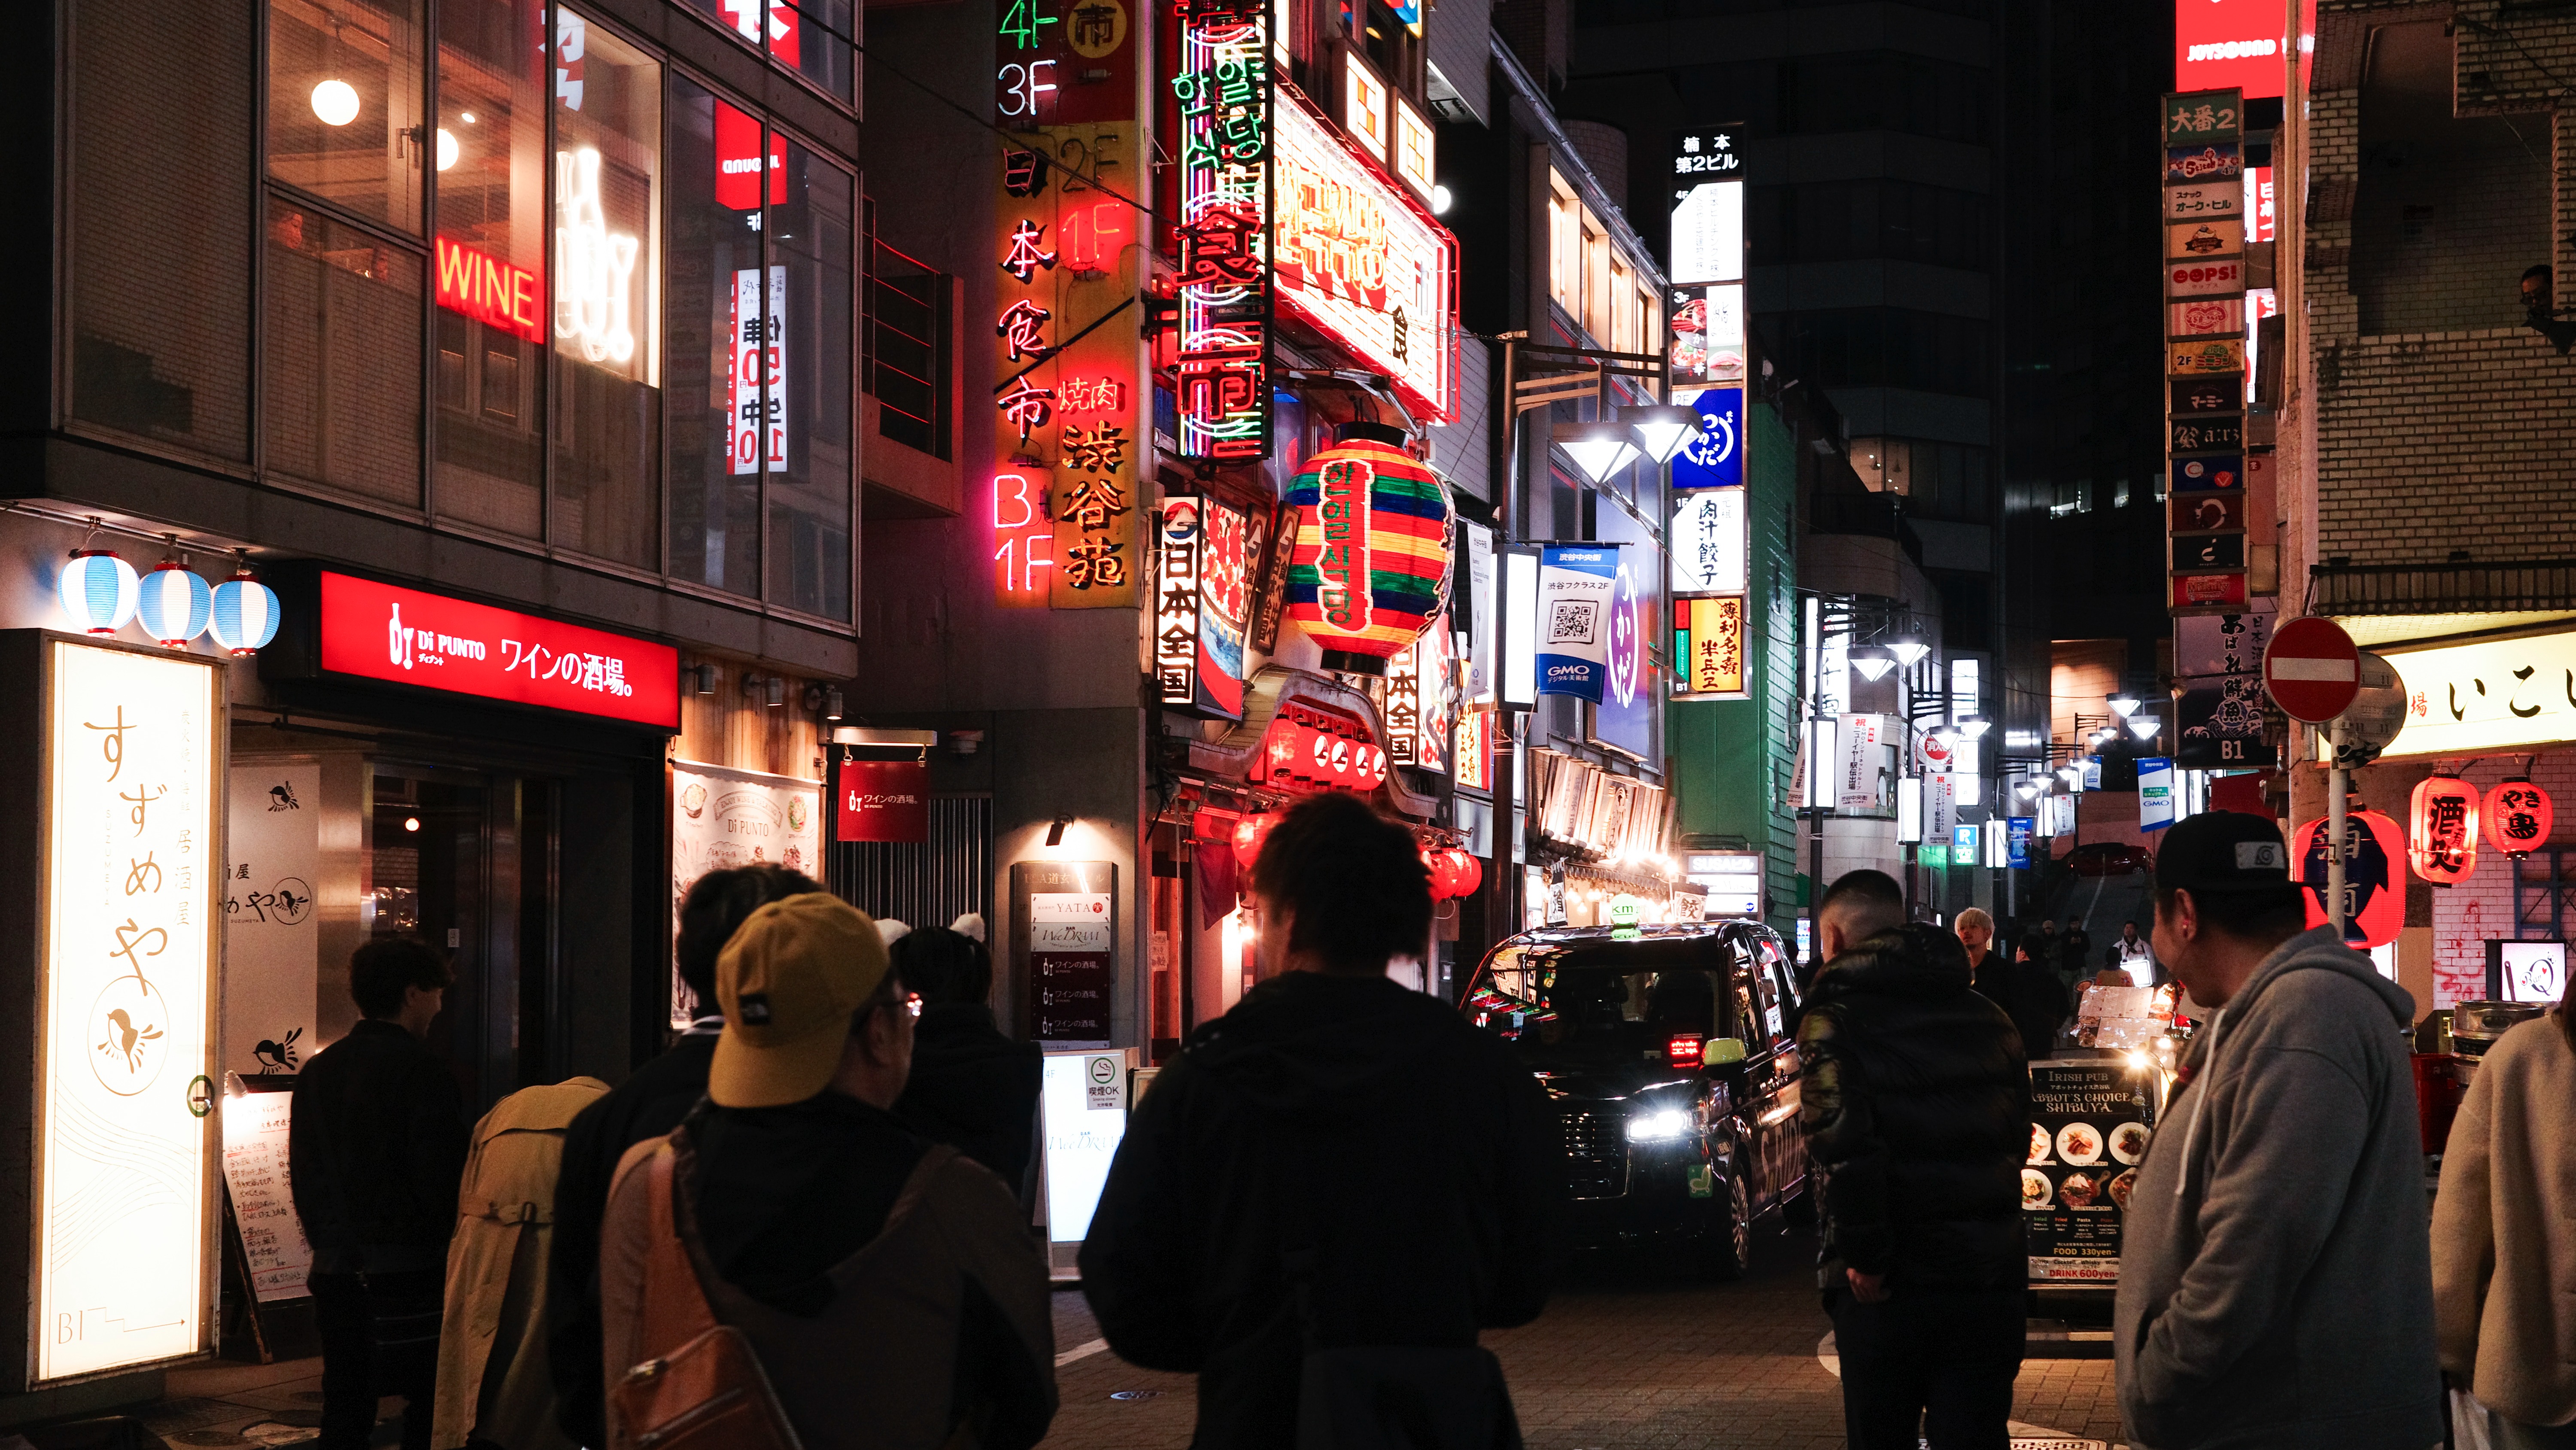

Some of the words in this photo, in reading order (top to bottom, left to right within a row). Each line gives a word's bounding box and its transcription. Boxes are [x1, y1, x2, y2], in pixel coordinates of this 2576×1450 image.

[2187, 39, 2276, 61] JOYSOUND
[999, 60, 1057, 115] 3F
[2171, 104, 2236, 132] 大番2
[1683, 134, 1730, 153] 楠本
[1060, 134, 1119, 192] 2F
[1675, 153, 1739, 173] 第2ビル
[1675, 190, 1689, 199] 4F
[2175, 200, 2232, 212] オーク・ヒル
[1062, 203, 1120, 262] 1F
[2173, 265, 2237, 283] OOPS!
[437, 237, 535, 327] WINE
[998, 148, 1054, 440] 日本食市
[1674, 291, 1689, 303] 3F
[1692, 333, 1706, 377] かに華
[2177, 356, 2192, 366] 2F
[1058, 377, 1118, 410] 焼肉
[1676, 395, 1689, 406] 2F
[1698, 413, 1720, 466] つかだ
[1062, 419, 1122, 587] 渋谷苑
[1676, 498, 1689, 508] 1F
[1698, 499, 1719, 585] 肉汁餃子
[1558, 553, 1602, 562] 渋谷中央街
[1547, 581, 1596, 590] 渋谷フクラス
[1159, 542, 1197, 700] 日本全国
[417, 629, 434, 651] Di
[437, 635, 486, 661] PUNTO
[501, 638, 633, 698] ワインの酒場。
[1547, 665, 1590, 676] GMO
[1547, 675, 1589, 684] デジタル美術館
[1676, 682, 1688, 692] B1
[2410, 691, 2428, 718] 場
[1855, 718, 1866, 727] 祝
[1926, 740, 1950, 752] 消火
[2221, 739, 2245, 760] B1
[1848, 727, 1861, 790] ニューイヤー駅伝出場
[737, 795, 750, 804] WINE
[864, 794, 919, 805] ワインの酒場。
[2500, 790, 2540, 809] やき
[728, 819, 737, 833] Di
[740, 823, 769, 836] PUNTO
[83, 705, 168, 997] すずめや
[103, 809, 112, 907] SUZUMEYA
[174, 828, 193, 926] 居酒屋
[1057, 903, 1091, 912] YATA
[1612, 905, 1633, 913] km
[1055, 961, 1100, 969] ワインの酒場。
[1055, 990, 1100, 999] ワインの酒場。
[1054, 1020, 1099, 1028] ワインの酒場。
[1045, 1070, 1055, 1079] 4F
[2086, 1073, 2109, 1082] PUB
[1089, 1086, 1119, 1096] 喫煙OK
[2084, 1092, 2131, 1102] CHOICE
[2046, 1102, 2113, 1113] SHIBUYA
[2081, 1248, 2117, 1257] 330yen~
[2049, 1269, 2078, 1277] DRINK
[58, 1310, 83, 1344] B1
